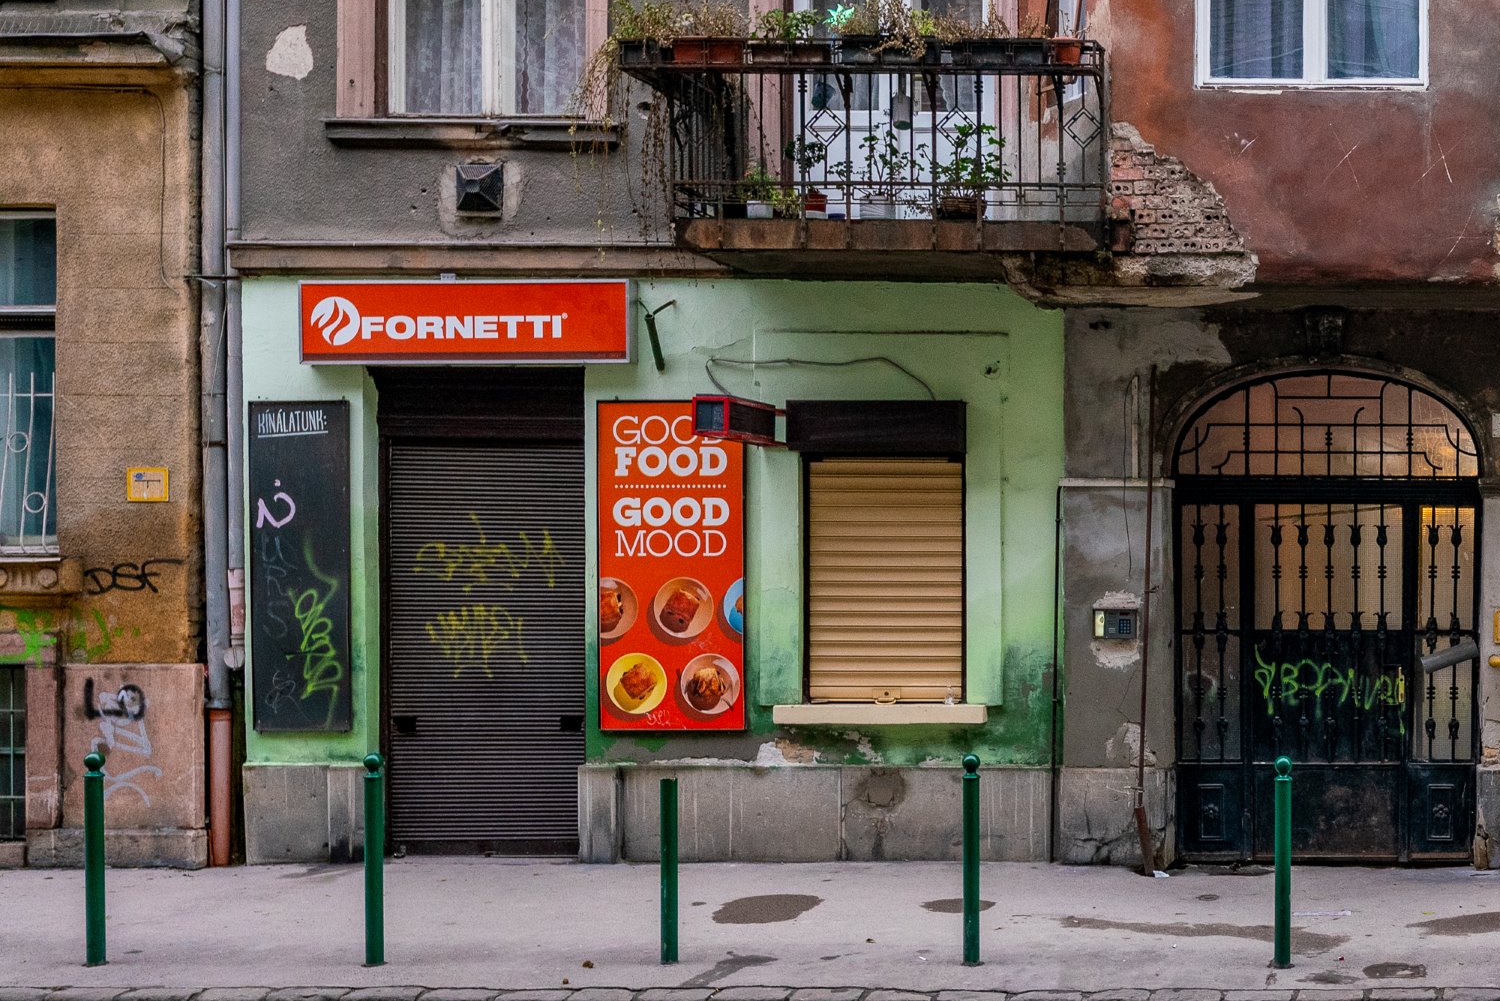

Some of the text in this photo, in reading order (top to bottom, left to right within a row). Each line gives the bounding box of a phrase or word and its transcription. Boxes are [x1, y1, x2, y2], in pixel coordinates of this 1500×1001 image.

[361, 315, 562, 340] FORNETTI
[257, 408, 328, 434] KÍNÁLATUNK:
[612, 415, 724, 445] GOO
[614, 446, 728, 477] FOOD
[612, 497, 730, 527] GOOD
[614, 529, 727, 557] MOOD
